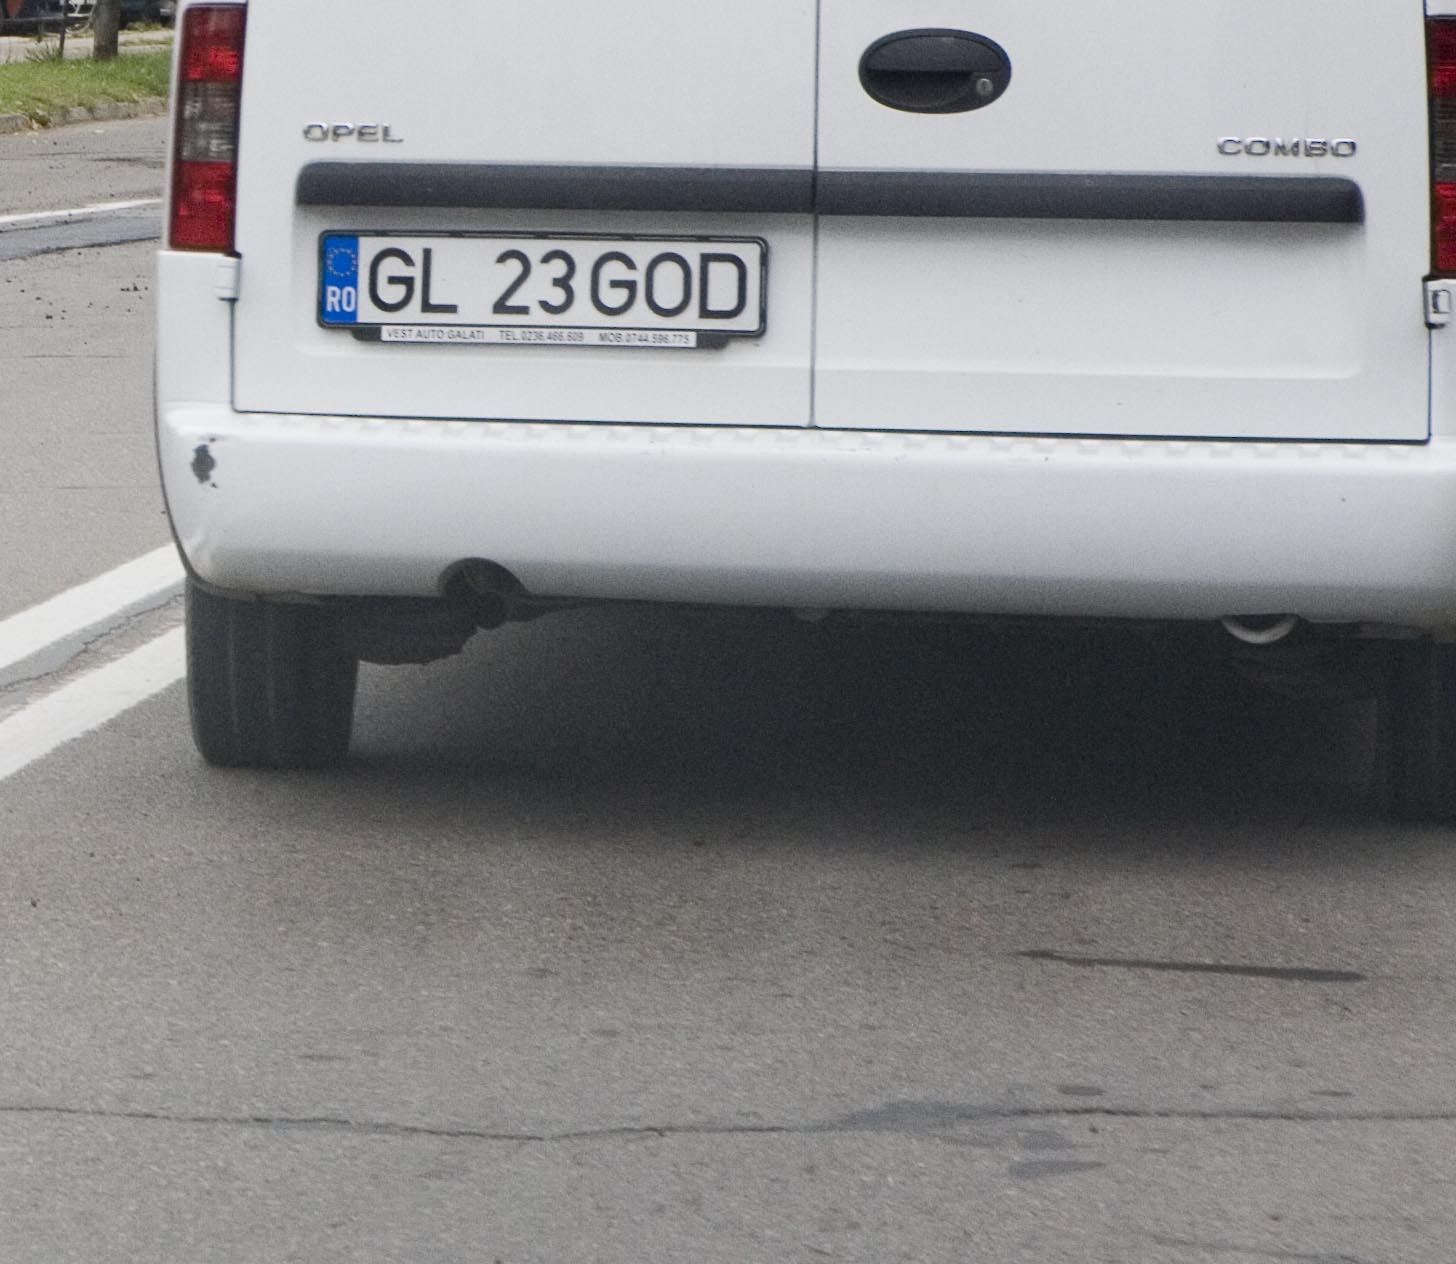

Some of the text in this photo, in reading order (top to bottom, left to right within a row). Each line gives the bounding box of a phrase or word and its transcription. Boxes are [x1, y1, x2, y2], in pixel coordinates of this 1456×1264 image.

[303, 122, 404, 143] OPEL
[1217, 136, 1358, 158] COMBO
[369, 247, 458, 314] GL
[326, 286, 356, 312] RO
[387, 328, 413, 338] VEST
[416, 328, 445, 340] AUTO
[447, 329, 485, 340] GALATI
